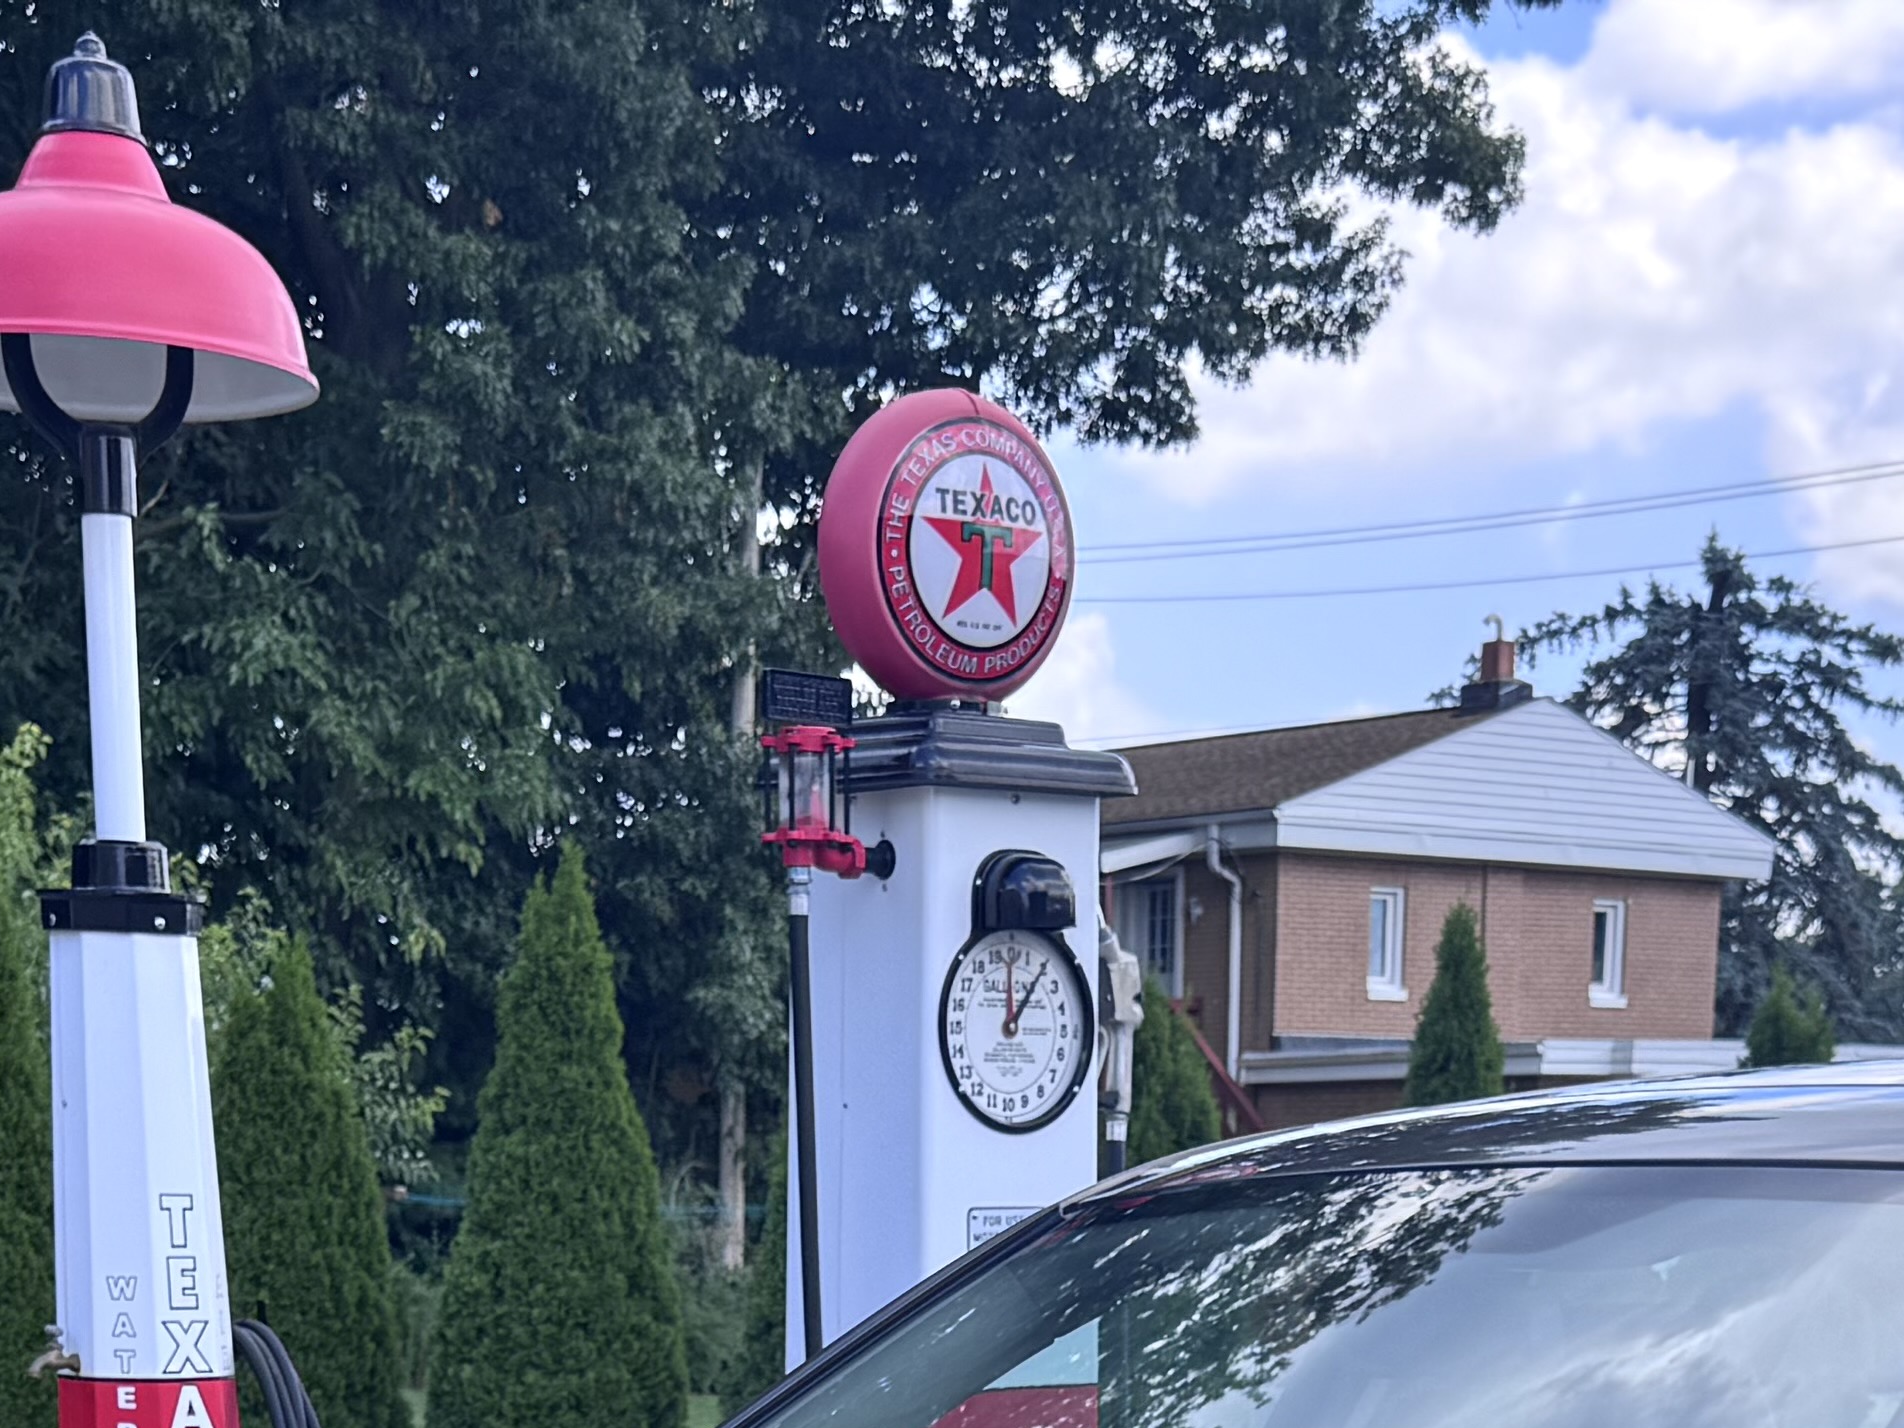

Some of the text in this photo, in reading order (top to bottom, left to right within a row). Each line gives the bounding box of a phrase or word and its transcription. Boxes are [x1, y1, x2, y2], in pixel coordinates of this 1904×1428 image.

[885, 492, 910, 542] THE
[900, 432, 956, 486] TEXAS
[961, 428, 1044, 488] COMPANY
[935, 488, 1036, 524] TEXACO
[887, 565, 1060, 674] PETROLEUM PRODUCTS
[972, 960, 985, 973] 18
[961, 978, 973, 992] 17
[1050, 981, 1059, 994] 3
[953, 999, 965, 1011] 16
[1058, 1002, 1065, 1015] 4
[950, 1022, 963, 1035] 15
[952, 1046, 964, 1058] 14
[1057, 1048, 1065, 1061] 6
[959, 1066, 972, 1079] 13
[1049, 1070, 1057, 1083] 7
[971, 1083, 984, 1096] 12
[1036, 1085, 1045, 1098] 8
[987, 1094, 997, 1108] 11
[1002, 1098, 1015, 1112] 10
[1021, 1095, 1029, 1108] 9
